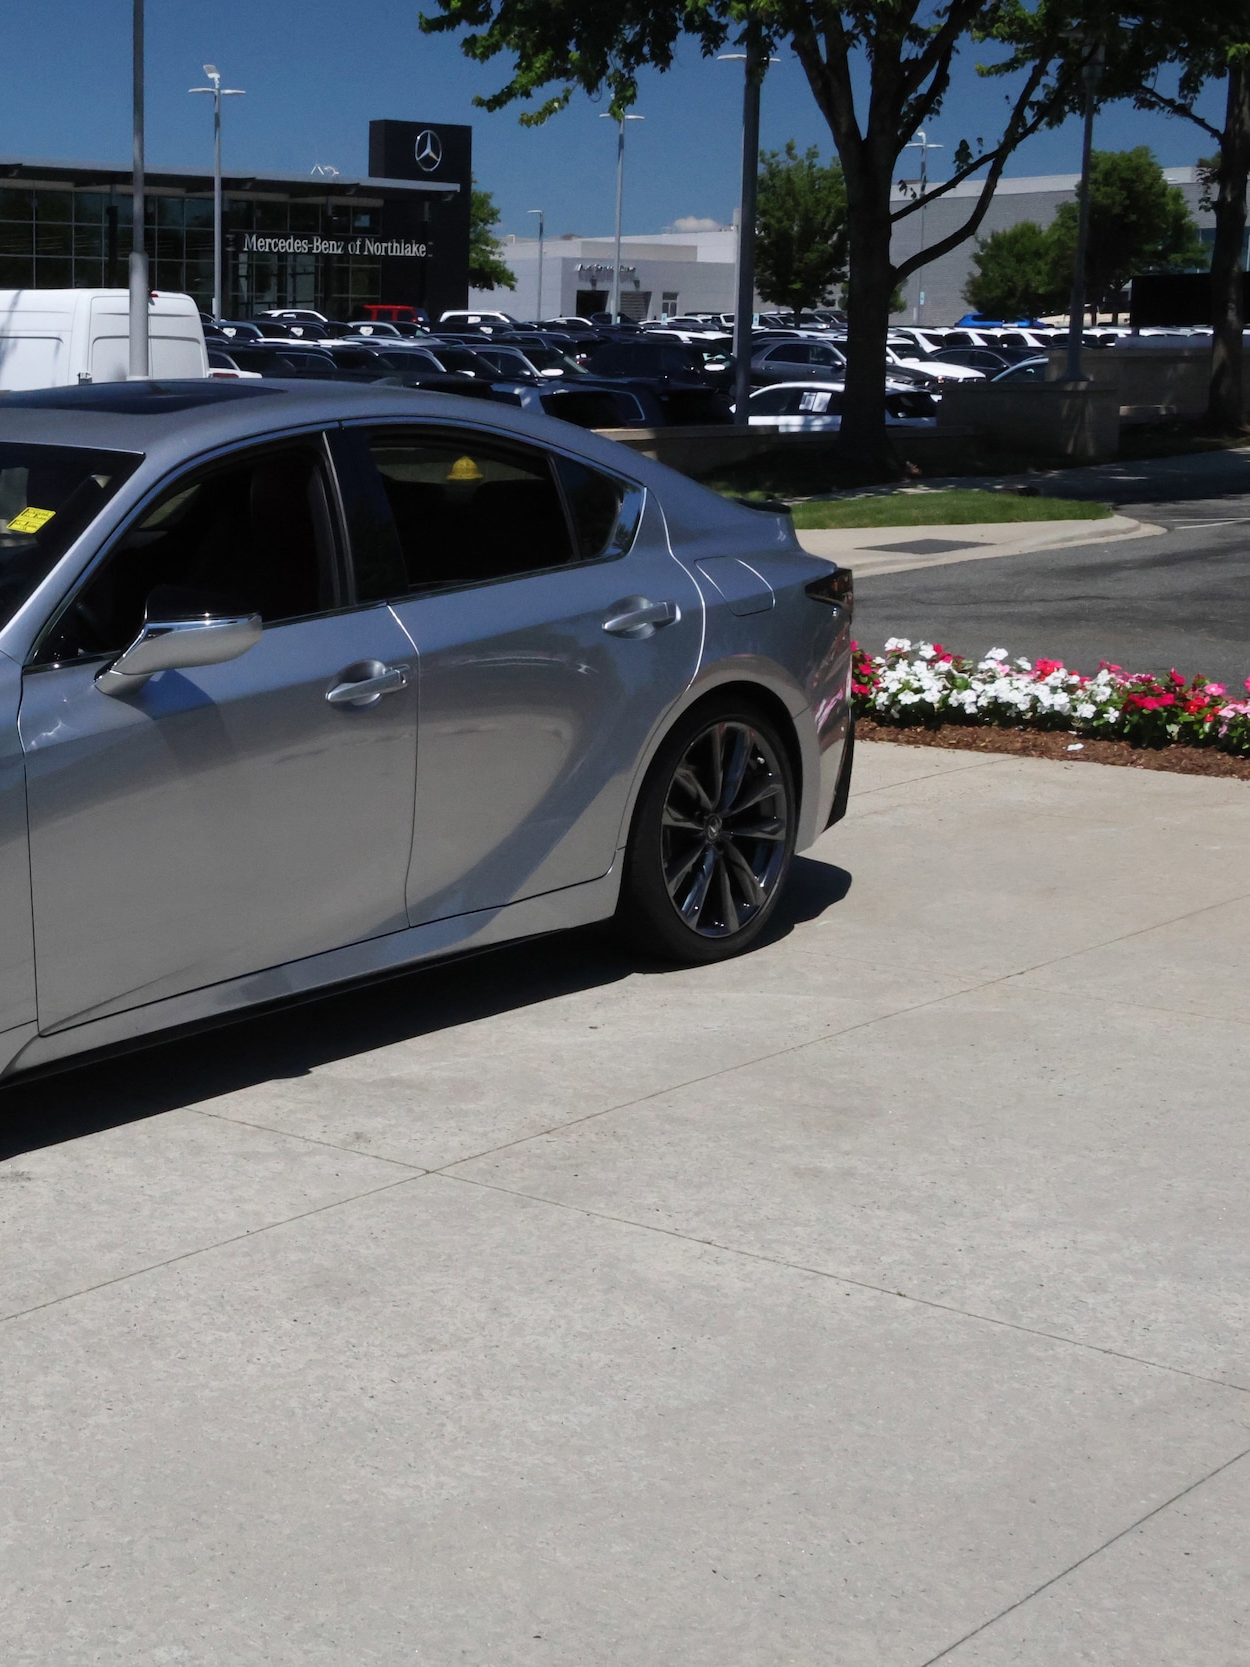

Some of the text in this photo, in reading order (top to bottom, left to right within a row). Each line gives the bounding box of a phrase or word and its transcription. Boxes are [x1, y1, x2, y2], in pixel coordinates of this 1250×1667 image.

[243, 233, 427, 257] Mercedes-Benz of Northlake
